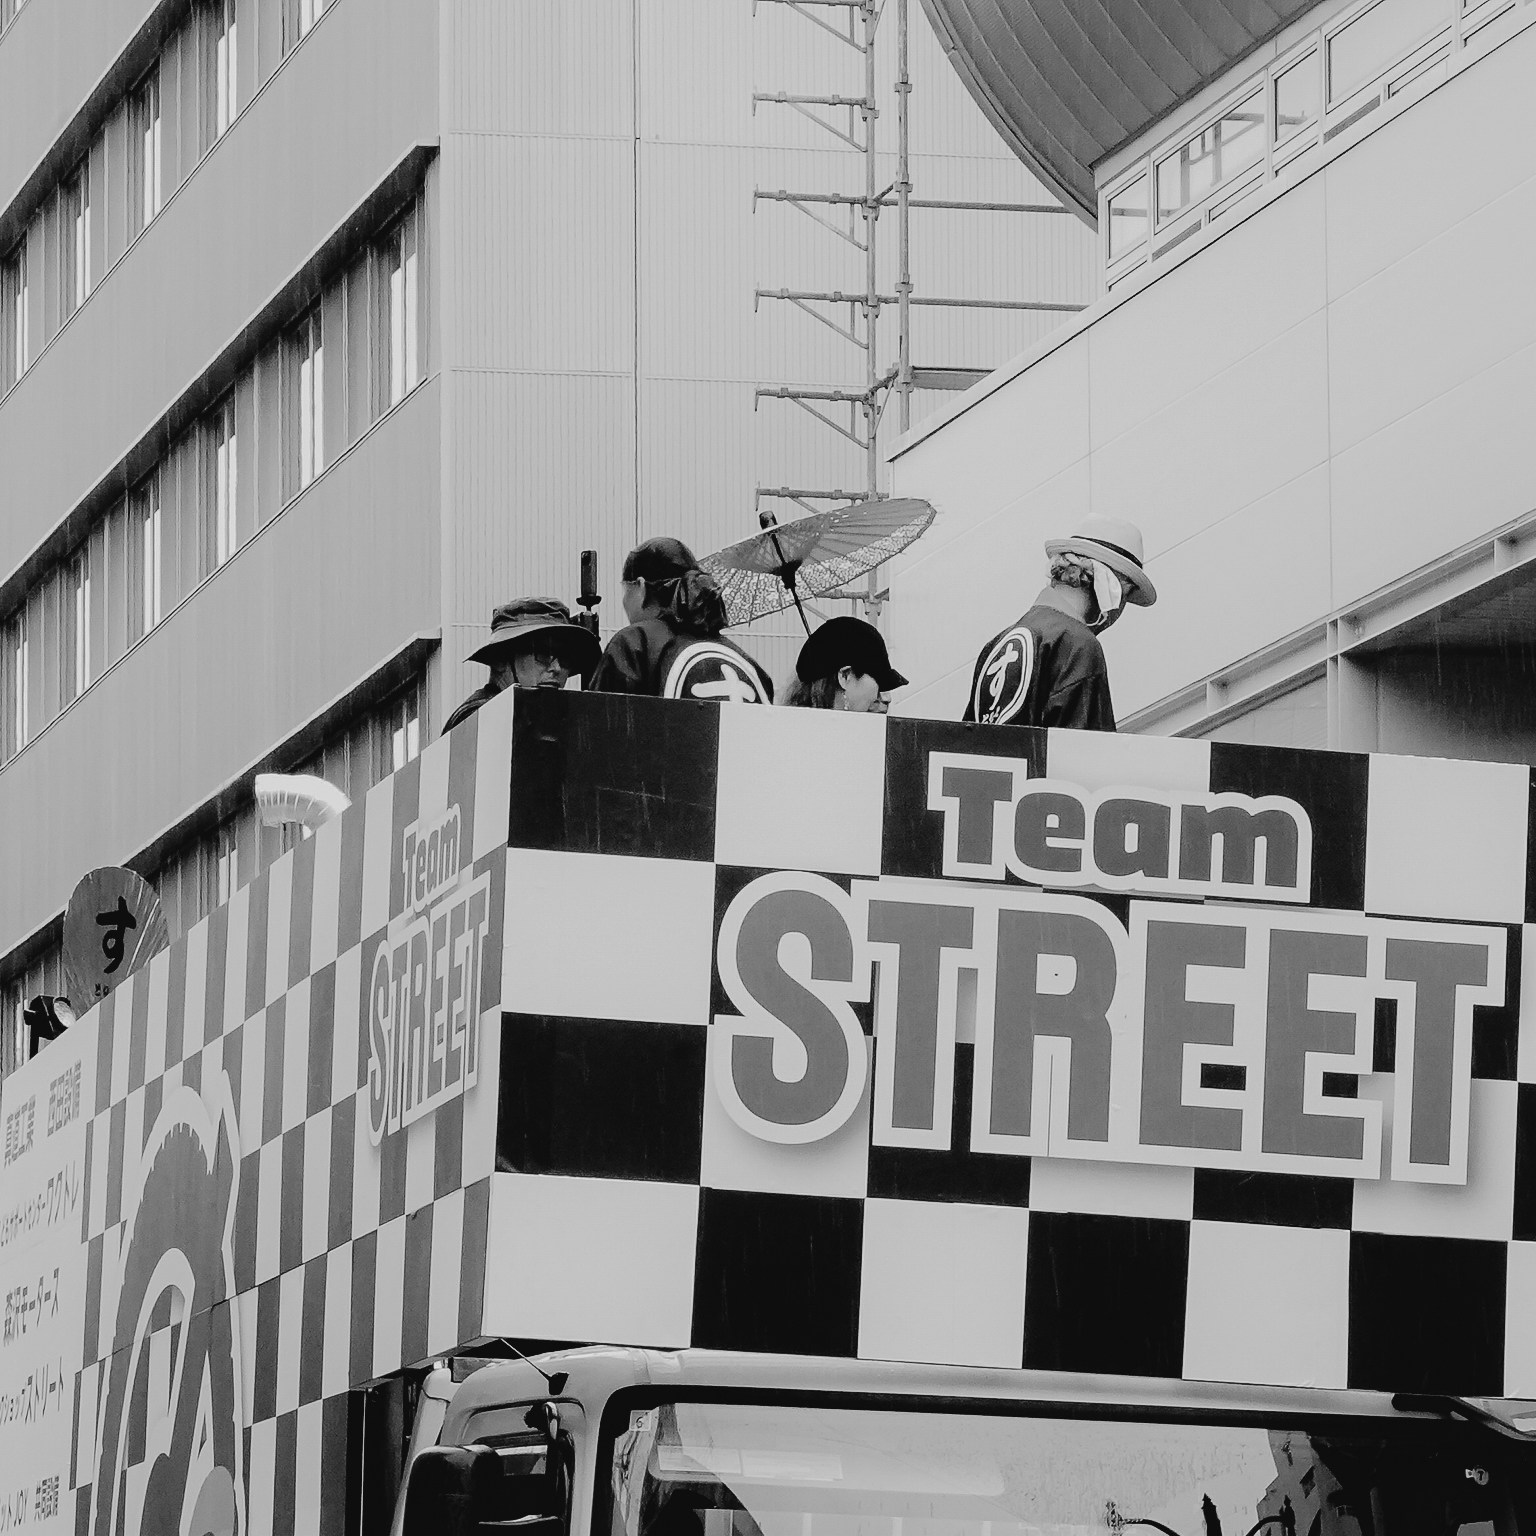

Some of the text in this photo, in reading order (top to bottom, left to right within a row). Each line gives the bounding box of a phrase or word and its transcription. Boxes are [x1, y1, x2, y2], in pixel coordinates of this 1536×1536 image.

[404, 808, 460, 911] Team
[932, 756, 1306, 898] Team
[96, 896, 136, 974] す
[369, 876, 489, 1142] STREET
[720, 878, 1500, 1178] STREET
